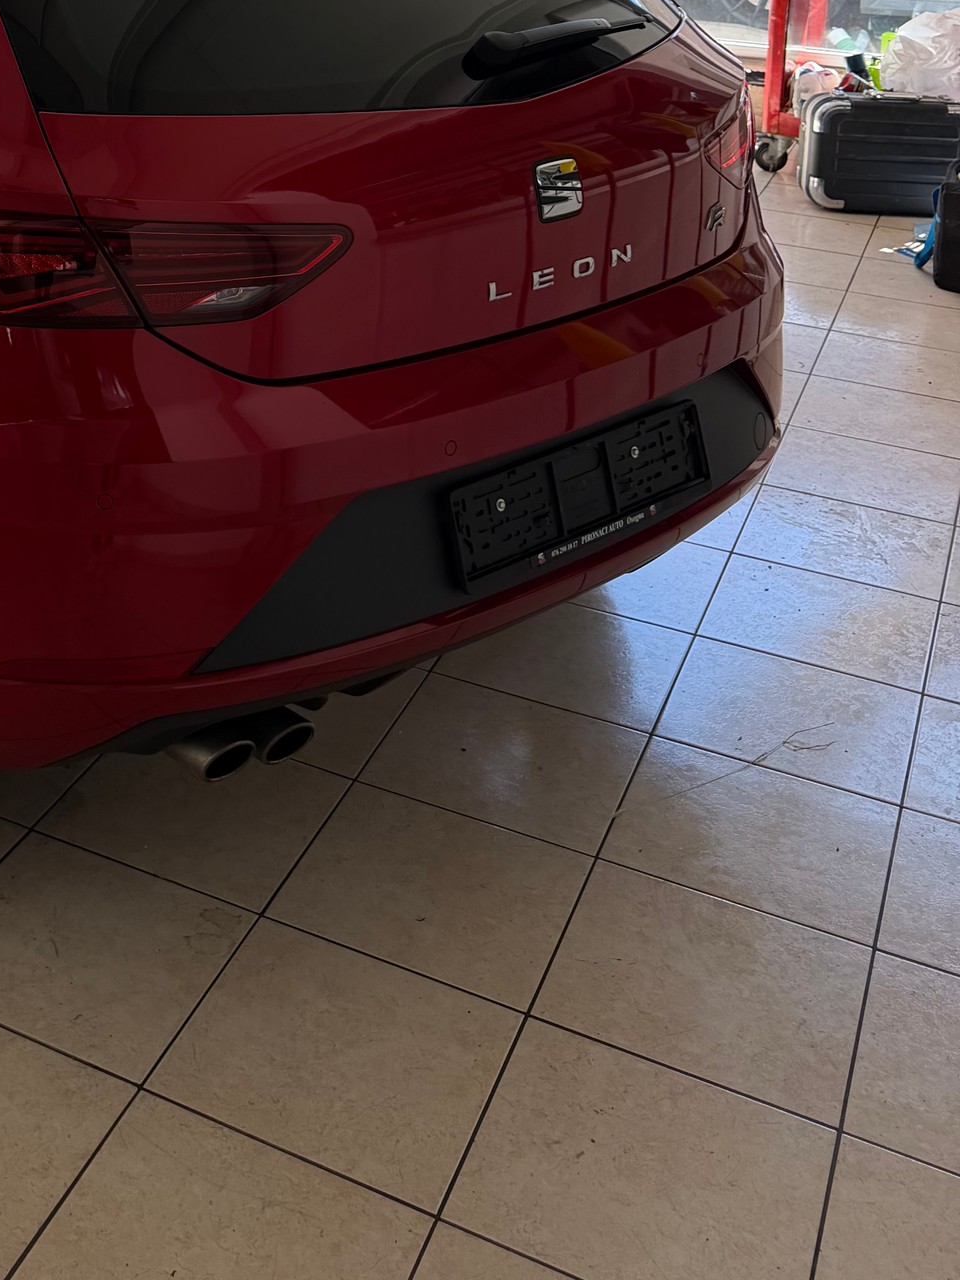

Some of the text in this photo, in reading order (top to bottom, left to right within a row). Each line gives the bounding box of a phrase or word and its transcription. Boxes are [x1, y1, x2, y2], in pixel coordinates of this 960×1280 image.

[488, 243, 632, 302] LEON
[581, 526, 608, 545] PIRONACI
[608, 519, 624, 533] AUTO
